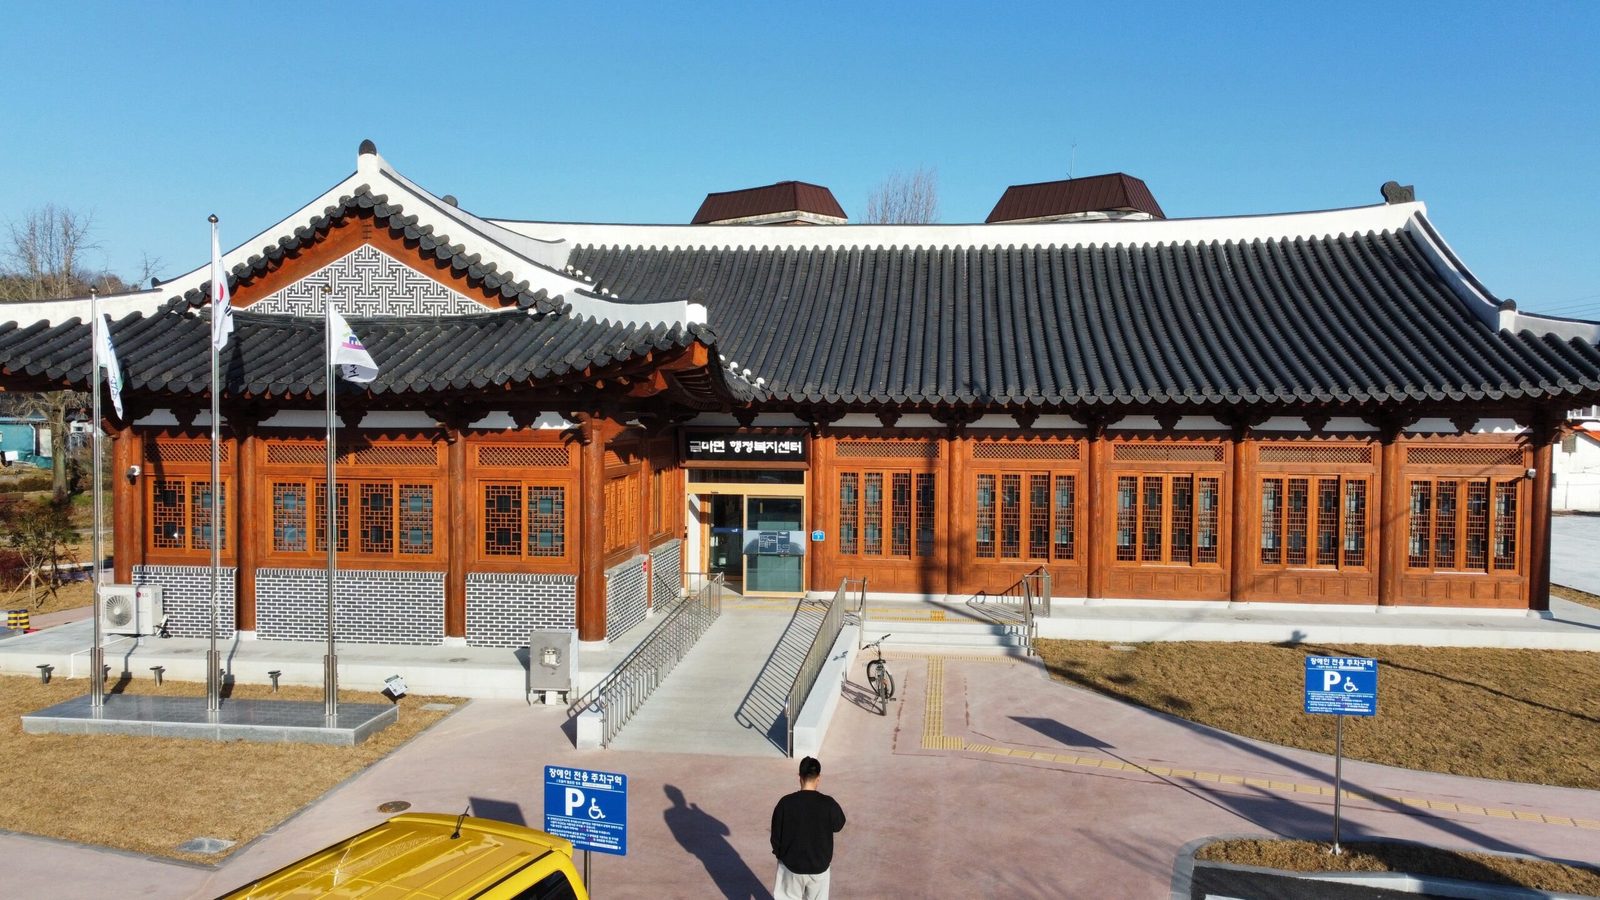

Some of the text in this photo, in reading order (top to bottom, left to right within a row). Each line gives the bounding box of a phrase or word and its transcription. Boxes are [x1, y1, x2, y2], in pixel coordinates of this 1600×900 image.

[729, 440, 802, 454] 행정복지센터
[1331, 658, 1344, 666] 전용
[1346, 659, 1373, 668] 주차구역
[1324, 671, 1341, 691] P
[549, 768, 571, 779] 장애인
[573, 771, 589, 782] 전용
[591, 773, 622, 786] 주차구역
[565, 787, 585, 816] P
